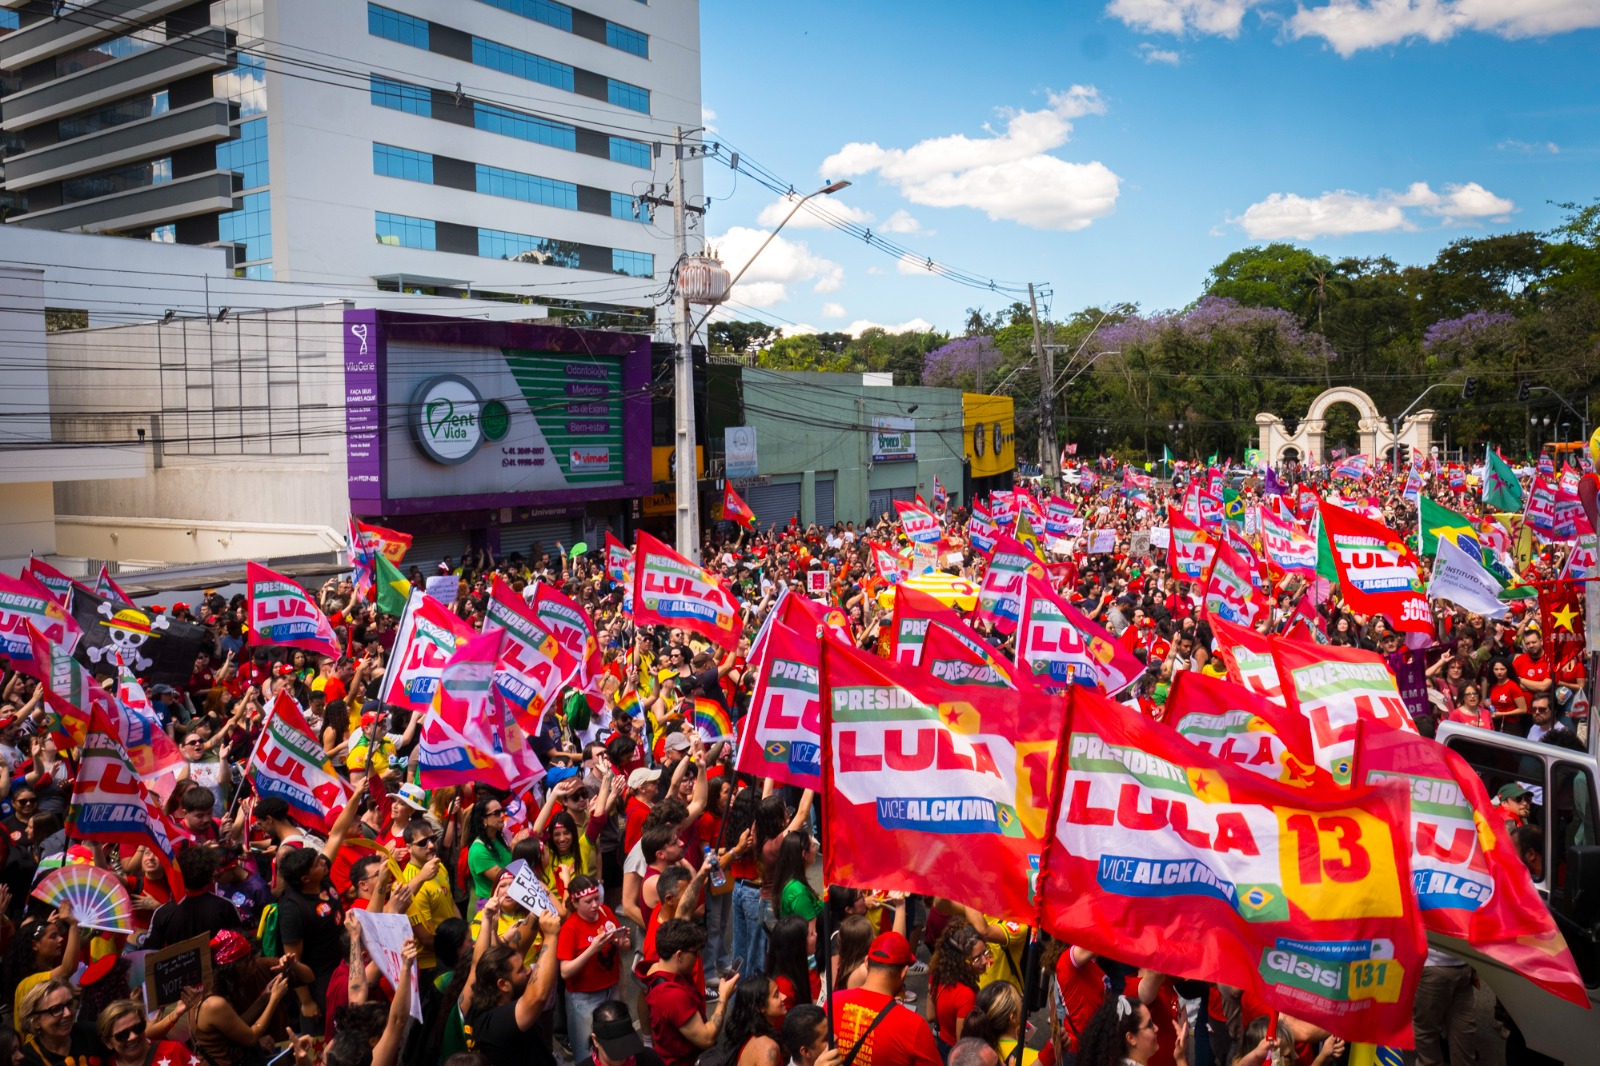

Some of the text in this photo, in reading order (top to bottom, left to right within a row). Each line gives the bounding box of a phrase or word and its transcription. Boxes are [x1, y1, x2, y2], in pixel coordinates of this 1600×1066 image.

[566, 364, 608, 378] Odontologia
[572, 384, 603, 394] Medicina
[444, 422, 467, 439] Vida
[570, 422, 606, 432] Bem-estar
[383, 542, 401, 555] 13
[1333, 534, 1386, 546] PRESIDENTE
[646, 554, 700, 577] PRESIDENTE
[1446, 566, 1480, 584] INSTITUTO
[644, 572, 724, 608] LULA
[1363, 578, 1408, 590] ALCKMIN
[257, 598, 320, 622] LUL
[672, 600, 716, 618] ALCKMIN
[718, 612, 729, 624] 13
[1408, 672, 1414, 683] É
[1408, 703, 1422, 713] DE
[838, 728, 1003, 780] LULA
[1072, 738, 1187, 786] PRESIDENTE
[256, 732, 341, 809] LULA
[83, 804, 112, 822] VICE
[880, 800, 996, 822] VICE ALCKMIN
[1066, 780, 1261, 857] LULA
[1285, 814, 1372, 886] 13
[1102, 858, 1234, 902] VICE ALCKMIN
[1266, 950, 1343, 990] Gleisi
[1353, 962, 1388, 989] 131
[163, 976, 184, 997] VOTE
